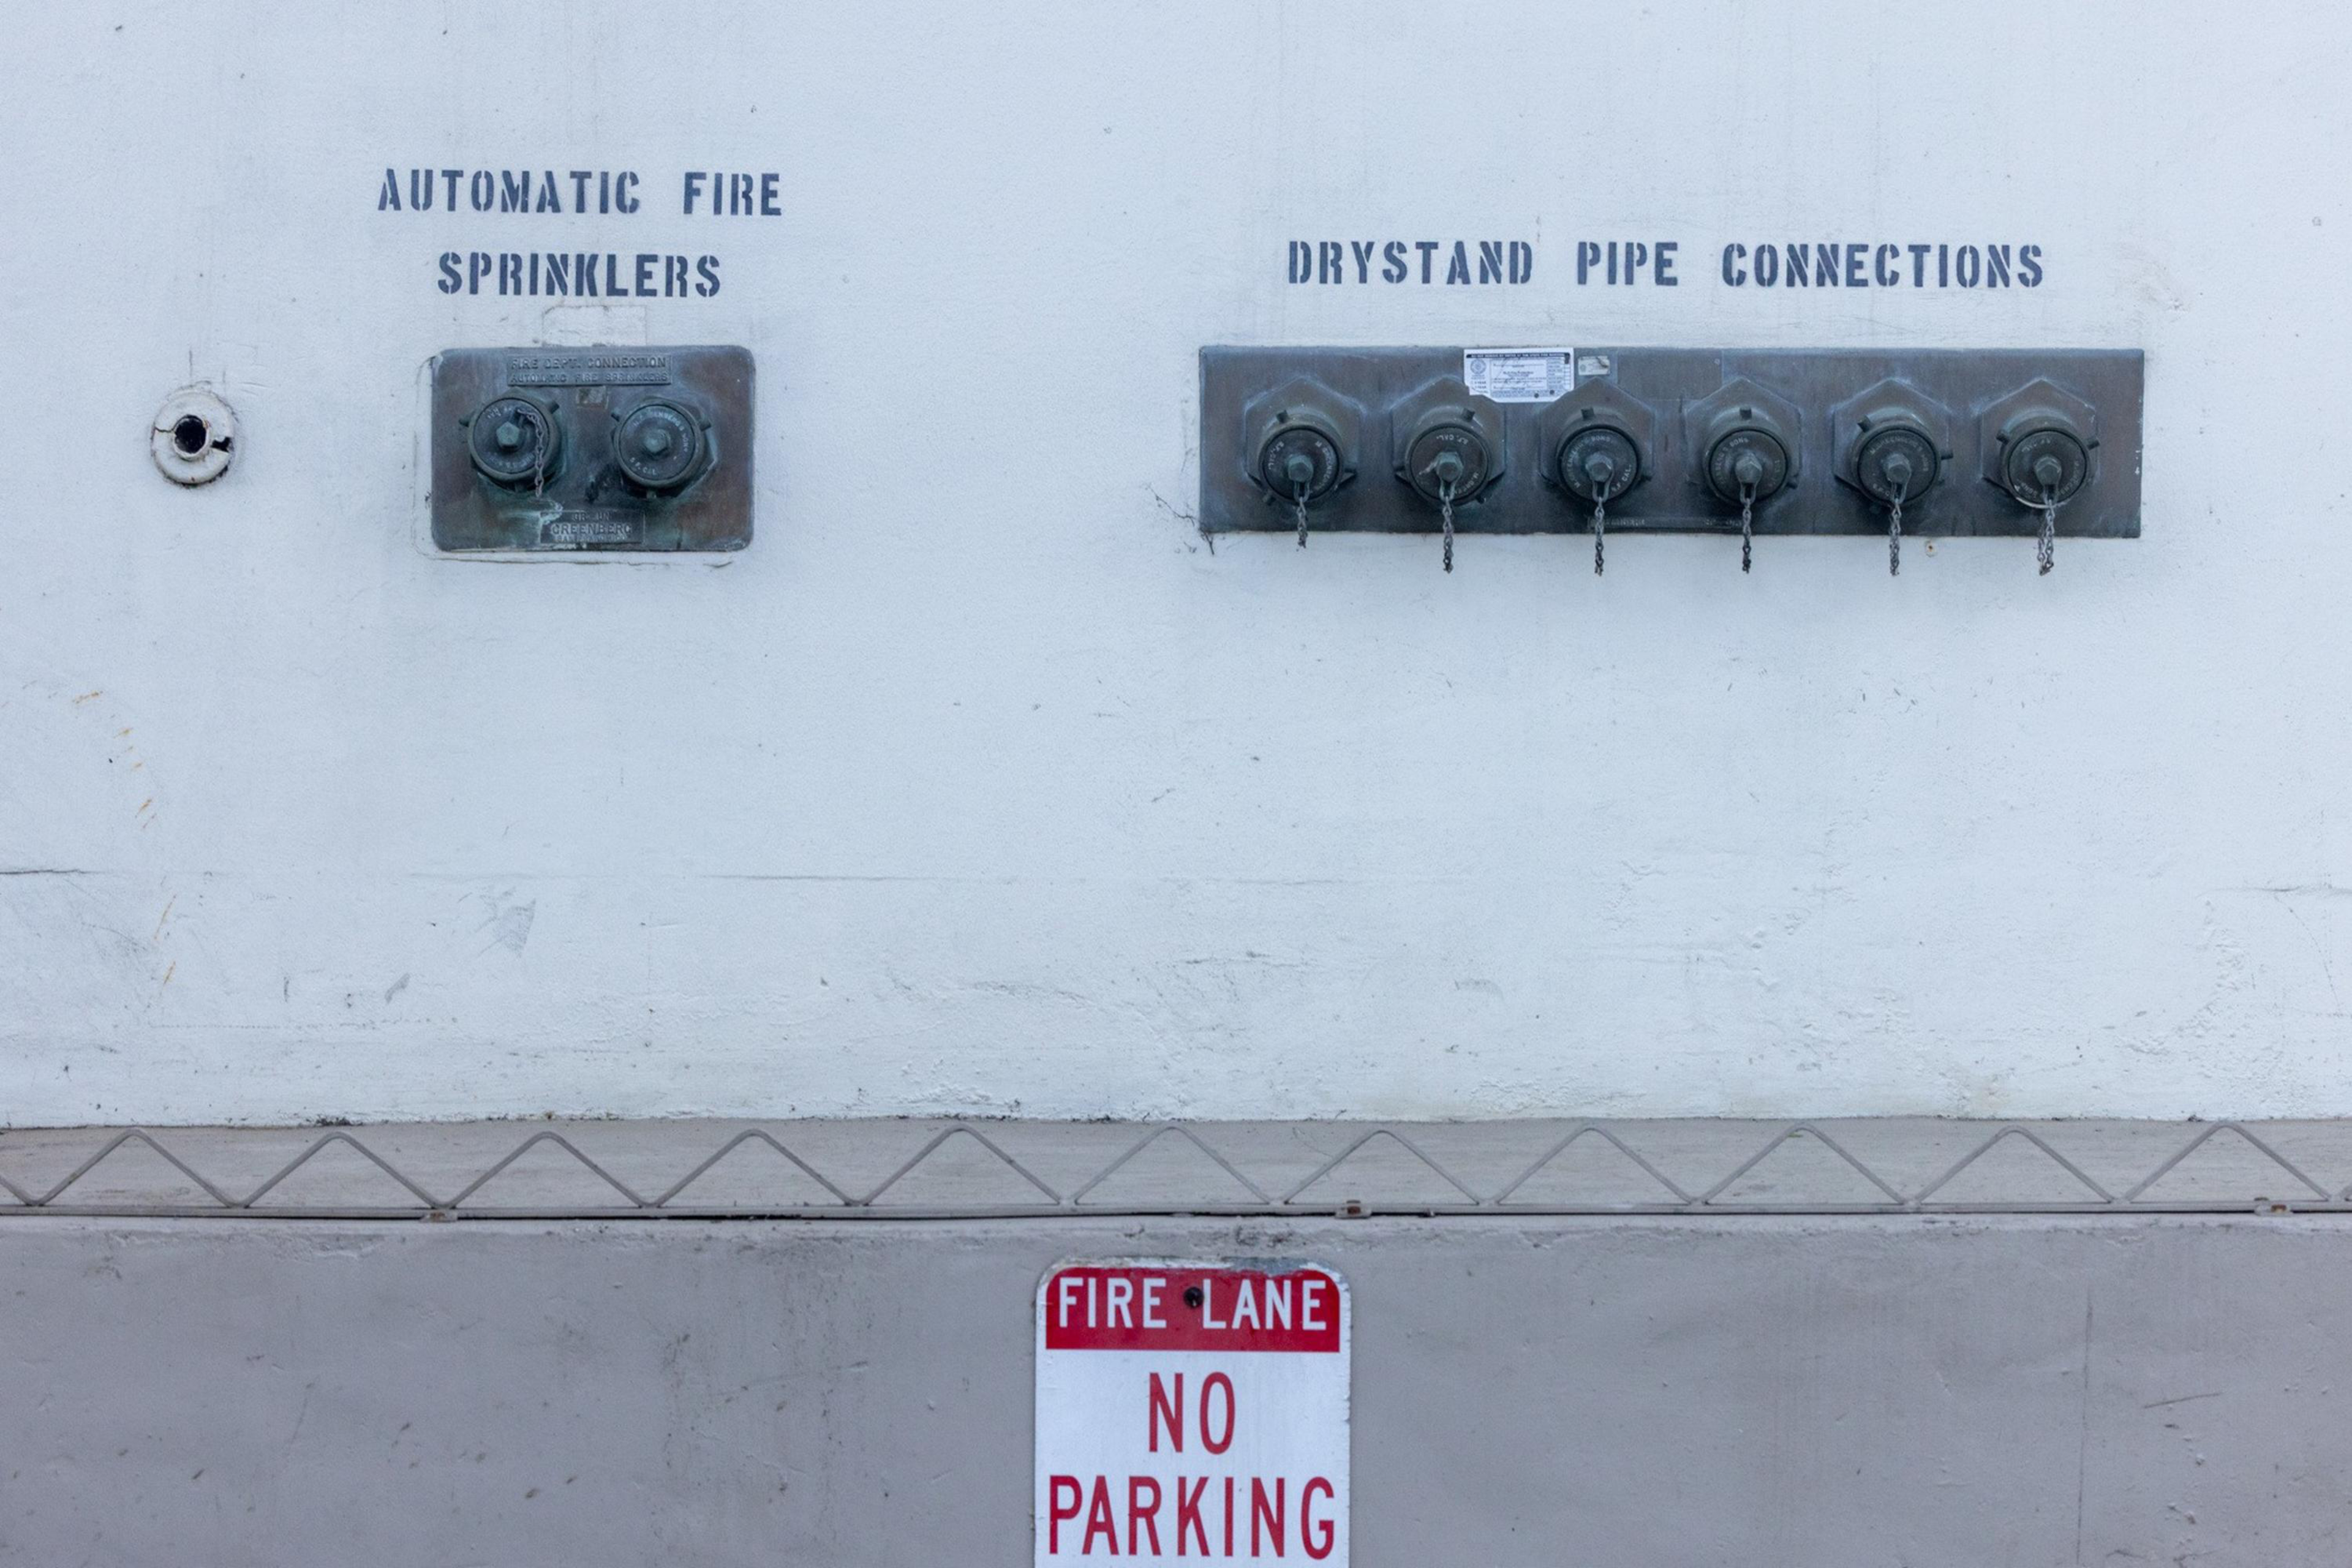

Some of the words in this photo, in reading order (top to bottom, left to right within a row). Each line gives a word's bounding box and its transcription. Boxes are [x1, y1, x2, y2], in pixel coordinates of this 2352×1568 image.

[378, 168, 639, 214] AUTOMATIC
[684, 172, 782, 216] FIRE
[438, 252, 720, 297] SPRINKLERS
[1289, 241, 1532, 285] DRYSTAND
[1578, 242, 1678, 286] PIPE
[1722, 244, 2042, 288] CONNECTIONS
[511, 357, 538, 369] FIRE
[588, 356, 666, 369] CONNECTION
[551, 522, 632, 535] GREENBERG
[1058, 1278, 1166, 1328] FIRE
[1203, 1278, 1327, 1330] LANE
[1149, 1371, 1235, 1455] NO
[1049, 1474, 1335, 1559] PARKING
